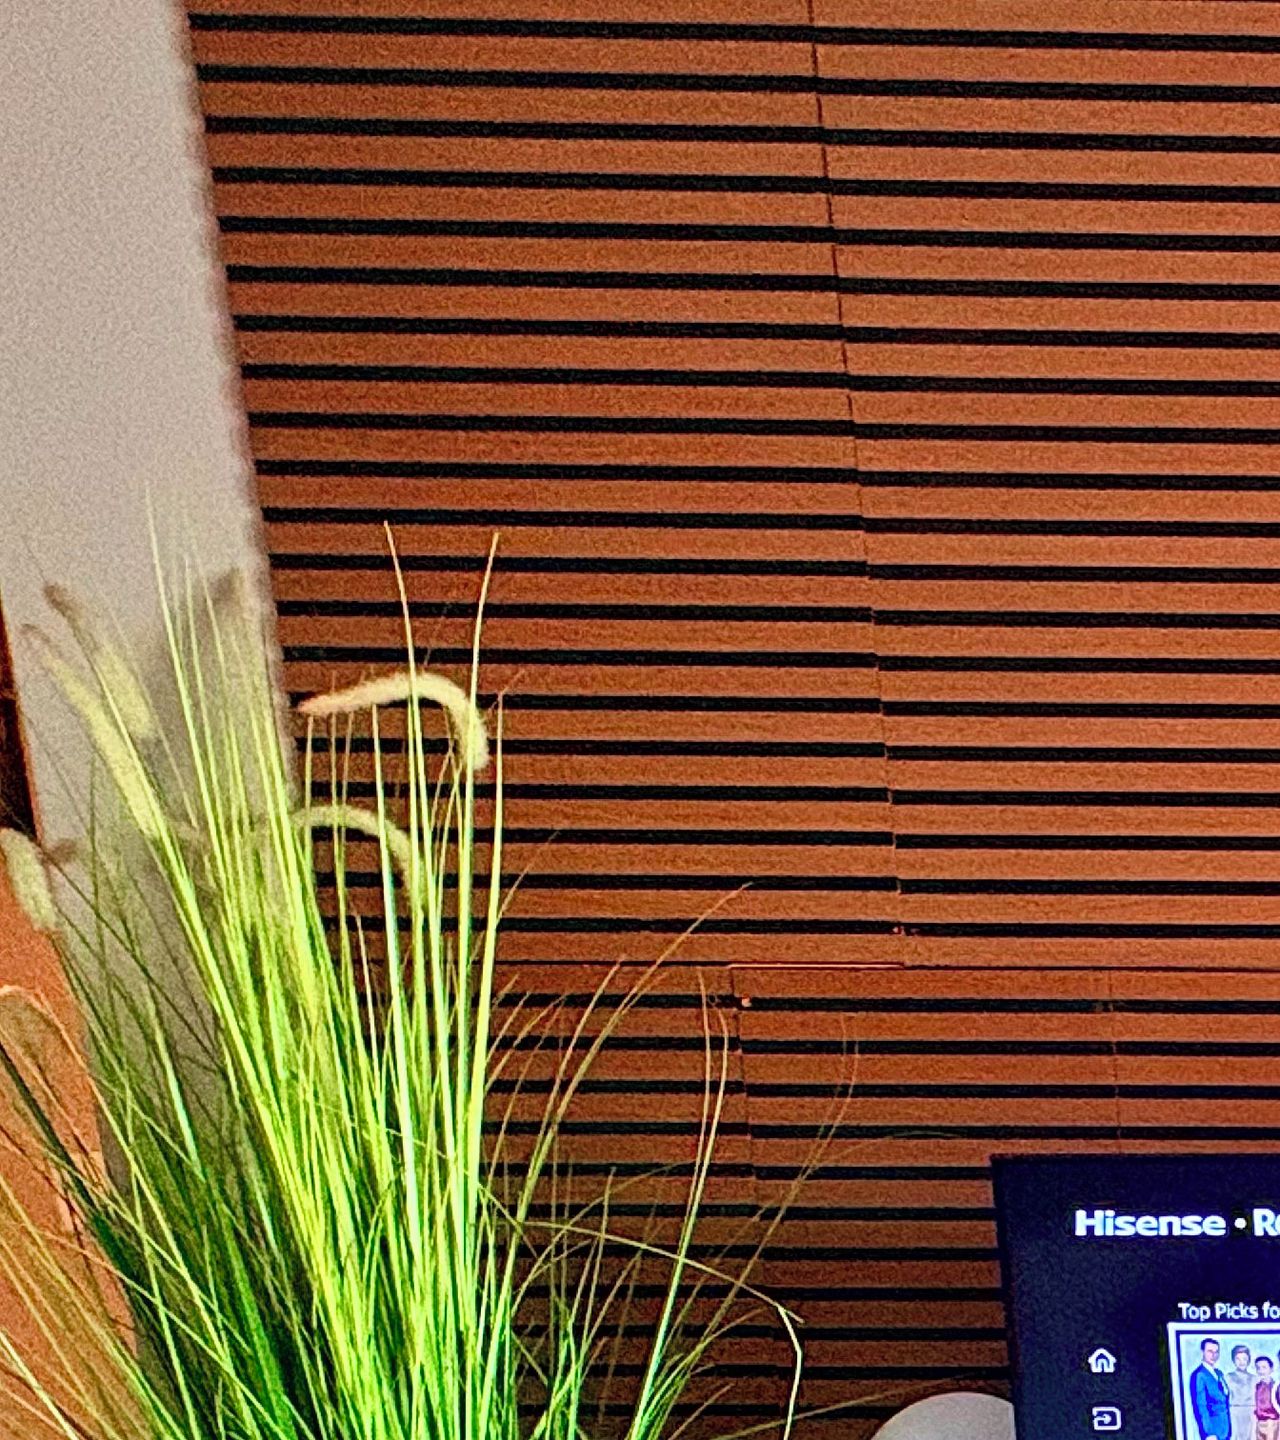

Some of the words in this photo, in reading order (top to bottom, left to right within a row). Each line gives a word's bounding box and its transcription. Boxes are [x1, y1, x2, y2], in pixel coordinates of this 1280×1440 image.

[1074, 1208, 1226, 1237] Hisense
[1178, 1302, 1210, 1321] Top
[1215, 1301, 1259, 1319] Picks
